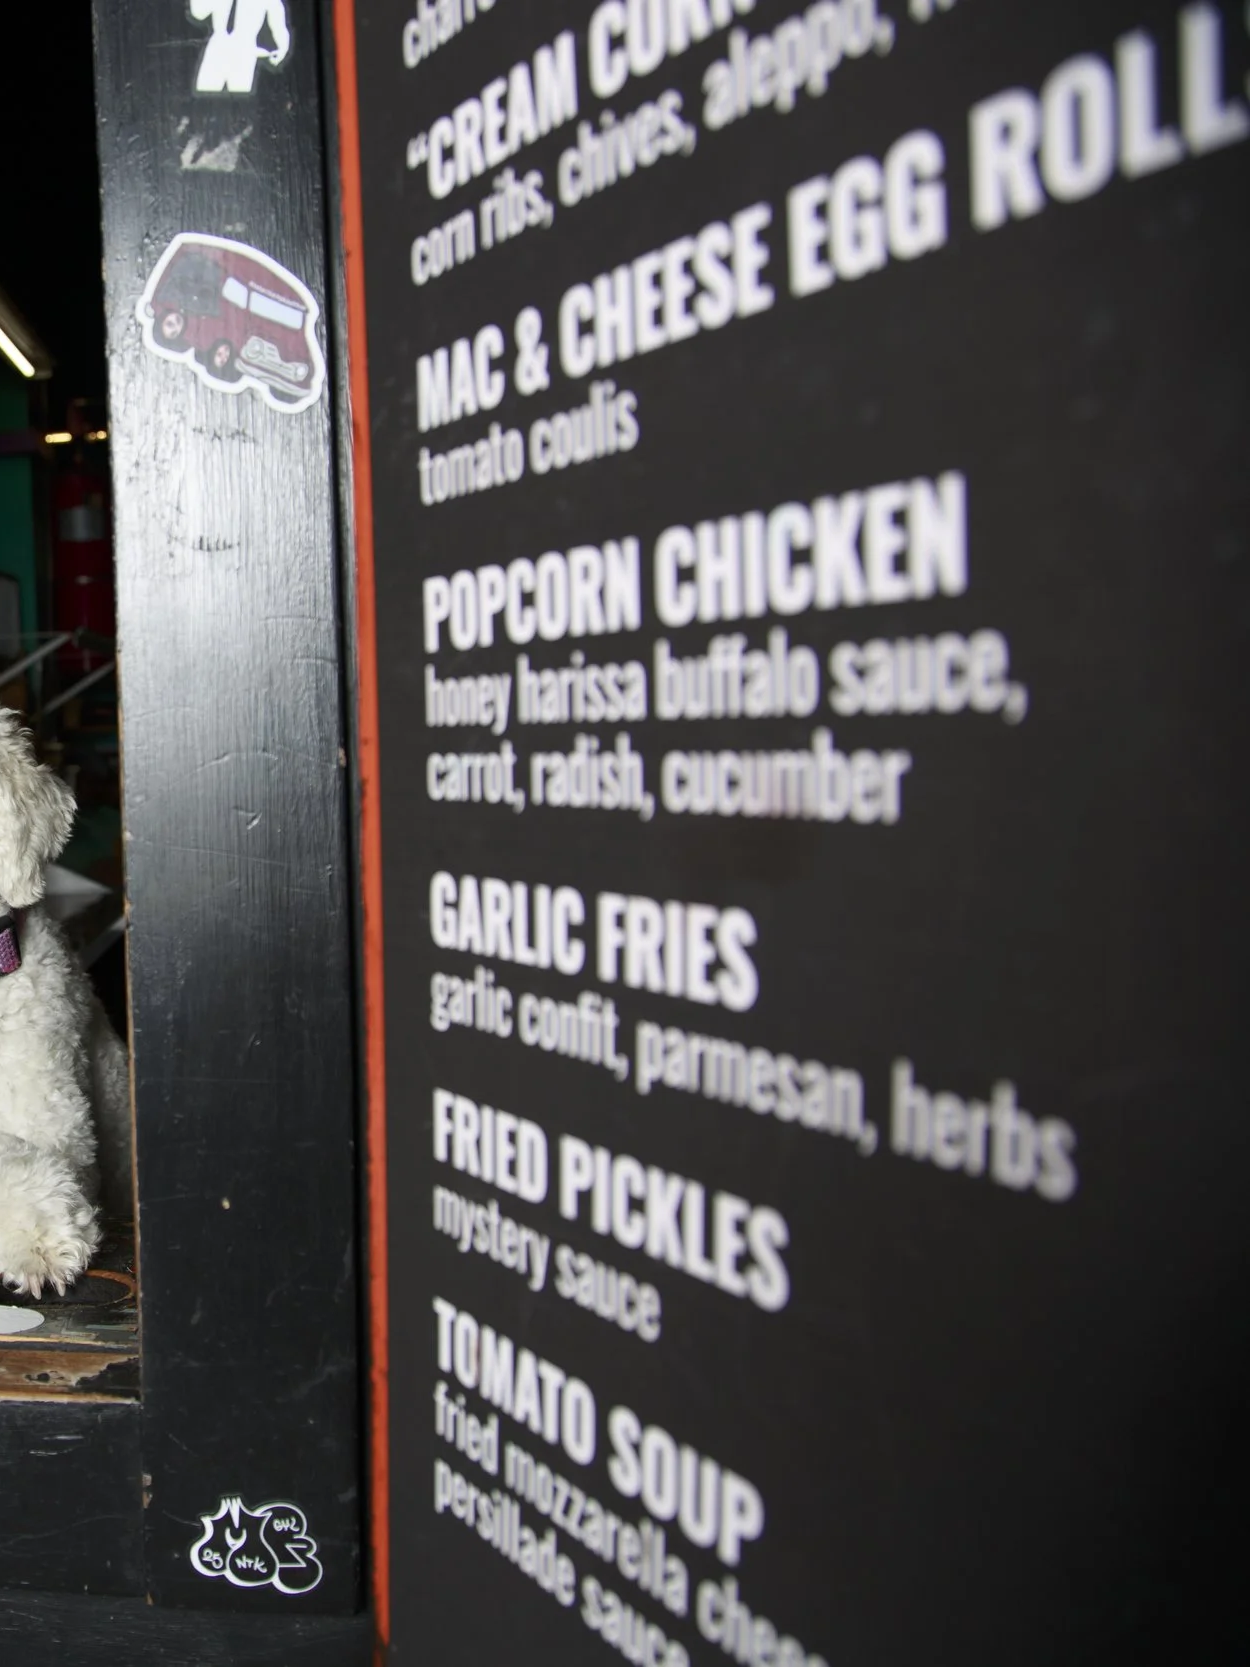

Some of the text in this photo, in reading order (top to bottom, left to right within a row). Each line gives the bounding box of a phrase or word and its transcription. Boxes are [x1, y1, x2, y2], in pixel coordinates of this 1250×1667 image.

[410, 0, 894, 286] corn ribs, chives, aleppo,
[416, 324, 506, 433] MAC
[514, 306, 550, 396] &
[558, 203, 775, 379] CHEESE
[787, 131, 948, 297] EGG
[417, 379, 639, 506] tomato coulis
[422, 471, 967, 654] POPCORN CHICKEN
[424, 627, 1028, 736] honey harissa buffalo sauce,
[426, 727, 912, 824] carrot, radish, cucumber
[429, 870, 759, 1012] GARLIC FRIES
[430, 965, 1076, 1201] garlic confit, parmesan, herbs
[432, 1087, 789, 1311] FRIED PICKLES
[433, 1185, 661, 1342] mystery sauce
[432, 1296, 764, 1565] TOMATO SOUP
[433, 1381, 499, 1475] fried
[504, 1443, 688, 1616] mozzarella
[434, 1459, 576, 1606] persillade
